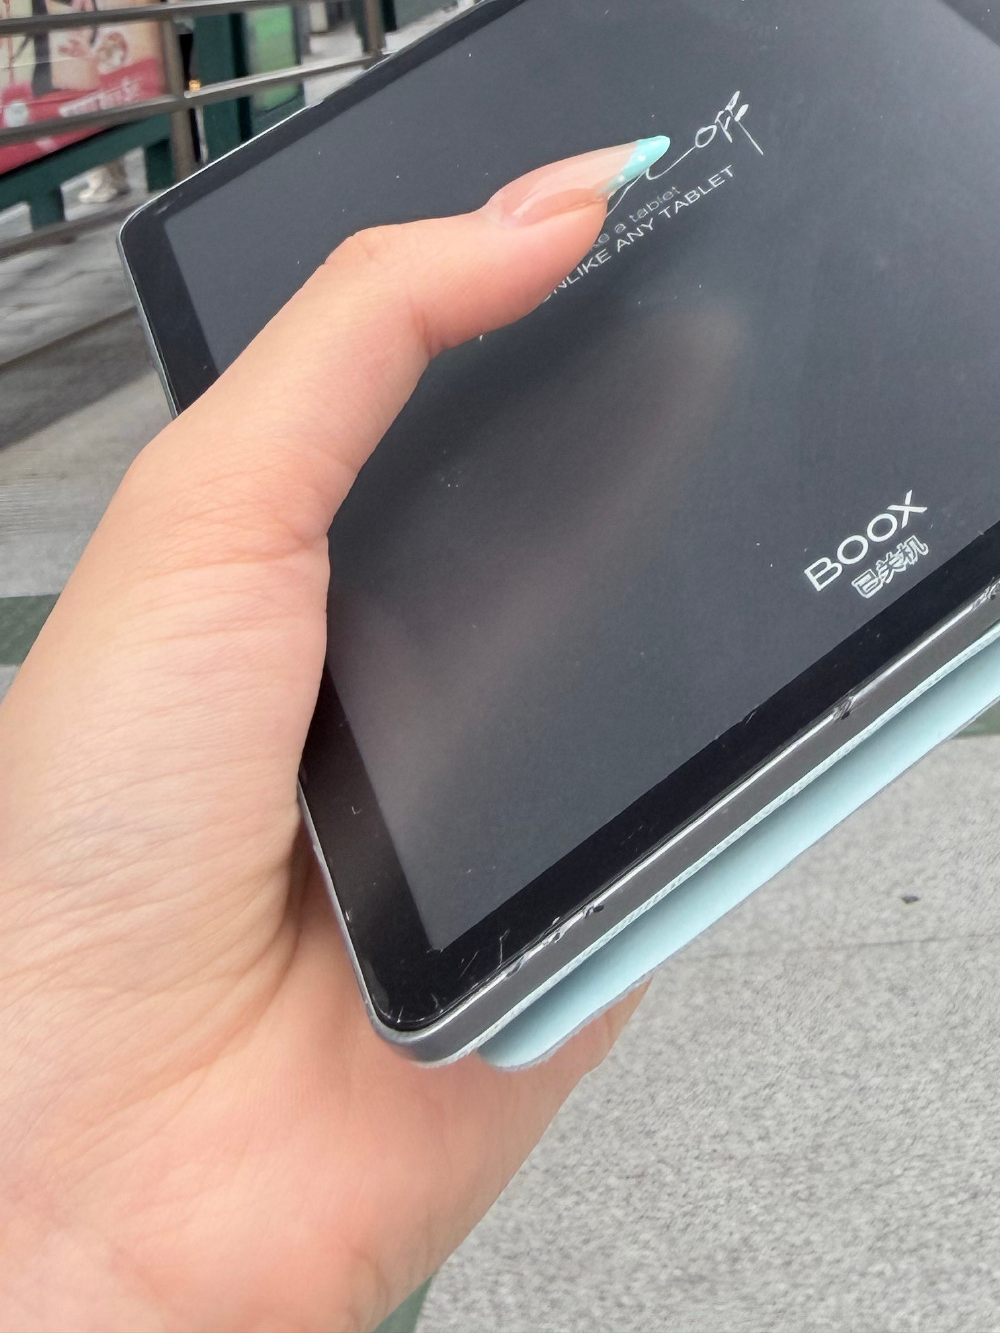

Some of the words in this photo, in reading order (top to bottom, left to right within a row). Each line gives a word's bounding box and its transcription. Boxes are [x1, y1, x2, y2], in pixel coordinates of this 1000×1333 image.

[543, 249, 612, 303] NLIKE
[617, 217, 654, 253] ANY
[658, 164, 734, 219] TABLET
[629, 186, 681, 223] tablet
[804, 489, 928, 592] BOOX
[851, 534, 929, 599] 已关机
